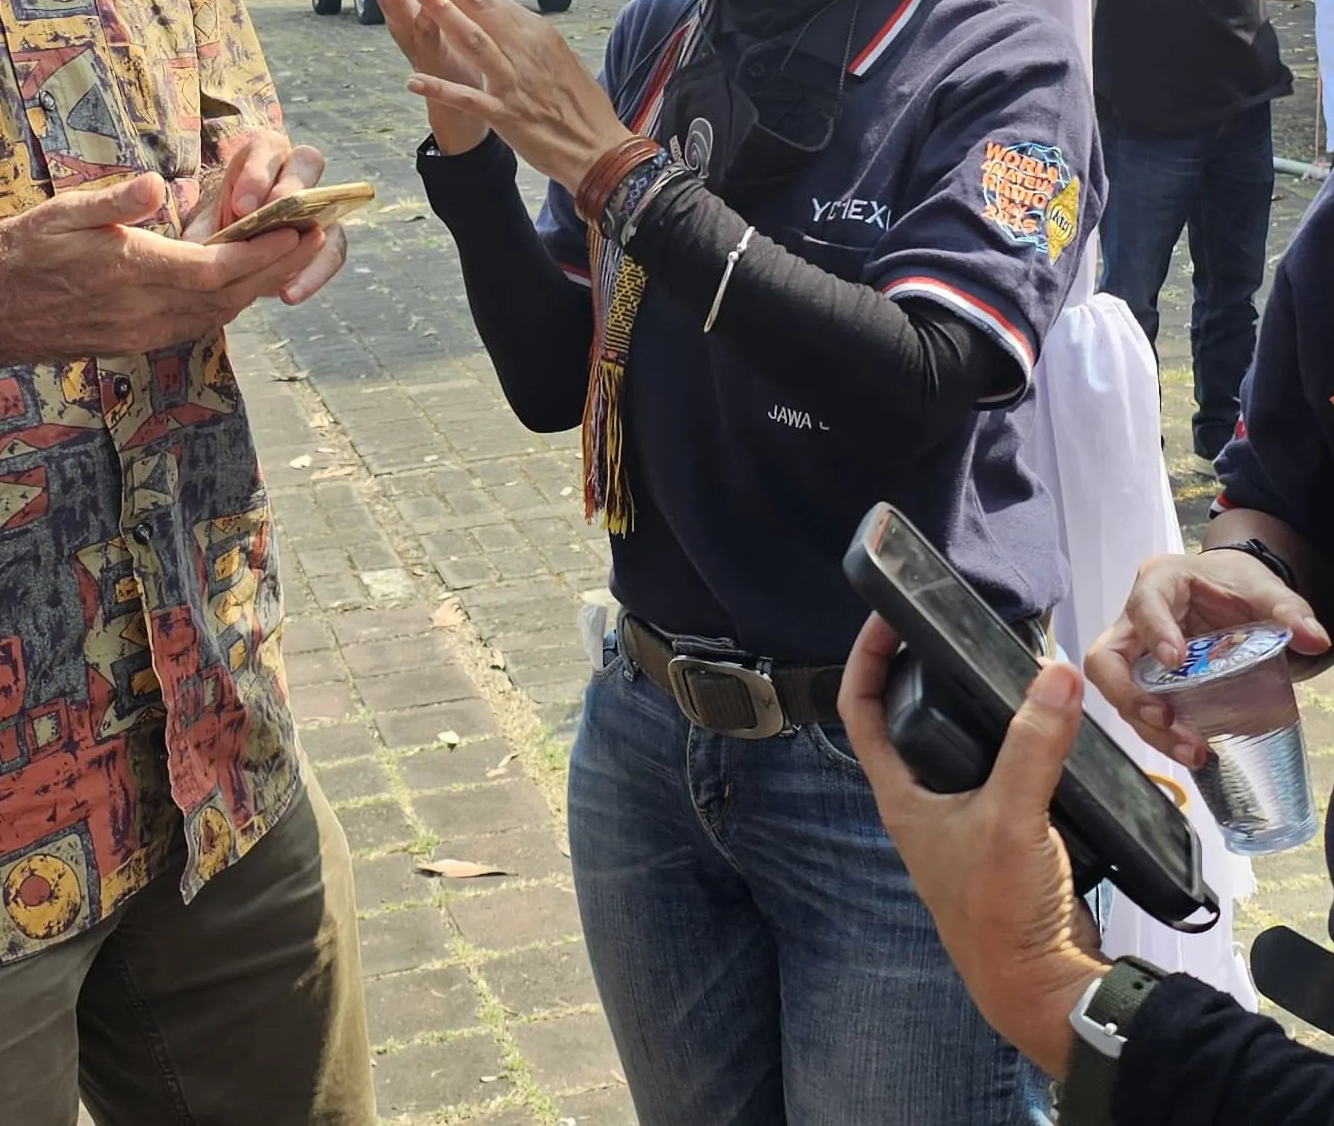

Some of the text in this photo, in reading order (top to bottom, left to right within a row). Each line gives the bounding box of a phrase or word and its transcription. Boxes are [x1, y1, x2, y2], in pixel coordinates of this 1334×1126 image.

[985, 141, 1060, 183] WORLD
[981, 173, 1048, 209] RADIO
[768, 404, 812, 430] JAWA
